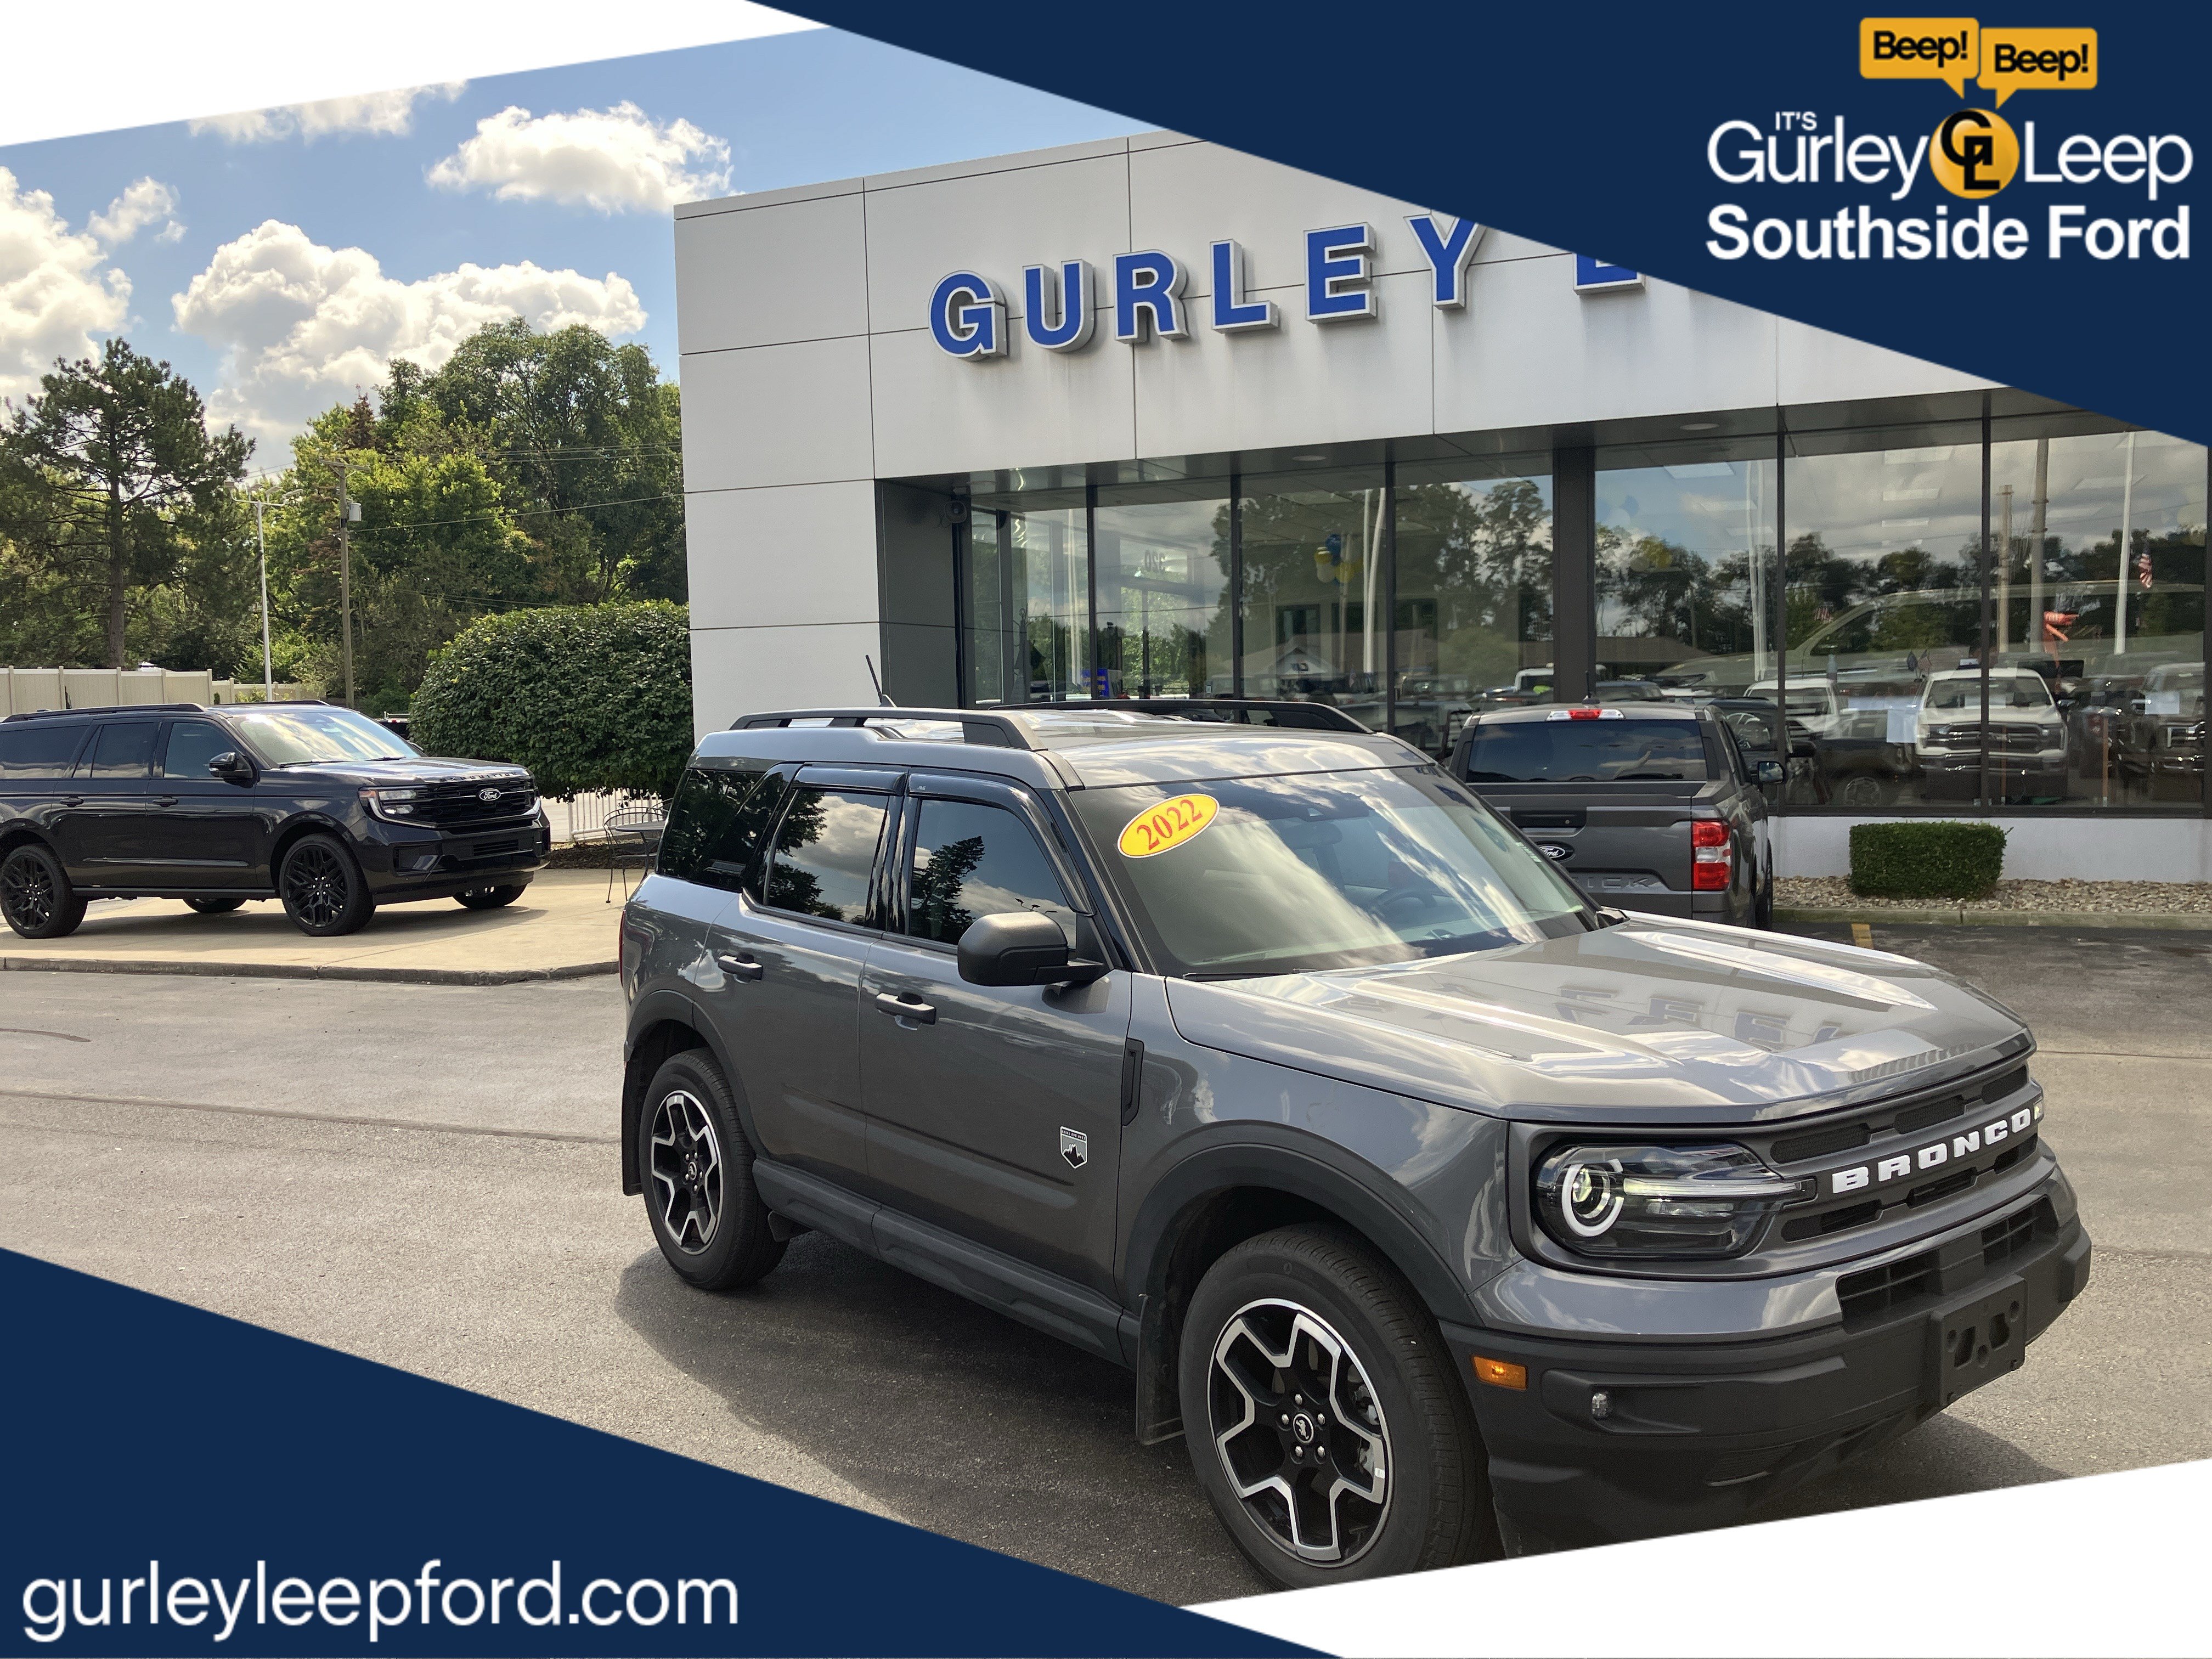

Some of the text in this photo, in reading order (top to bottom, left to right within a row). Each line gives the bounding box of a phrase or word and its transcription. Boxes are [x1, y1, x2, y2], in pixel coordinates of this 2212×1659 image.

[928, 213, 1486, 361] GURLEY
[1136, 799, 1203, 851] 2022
[1831, 1108, 2031, 1194] BRONCO
